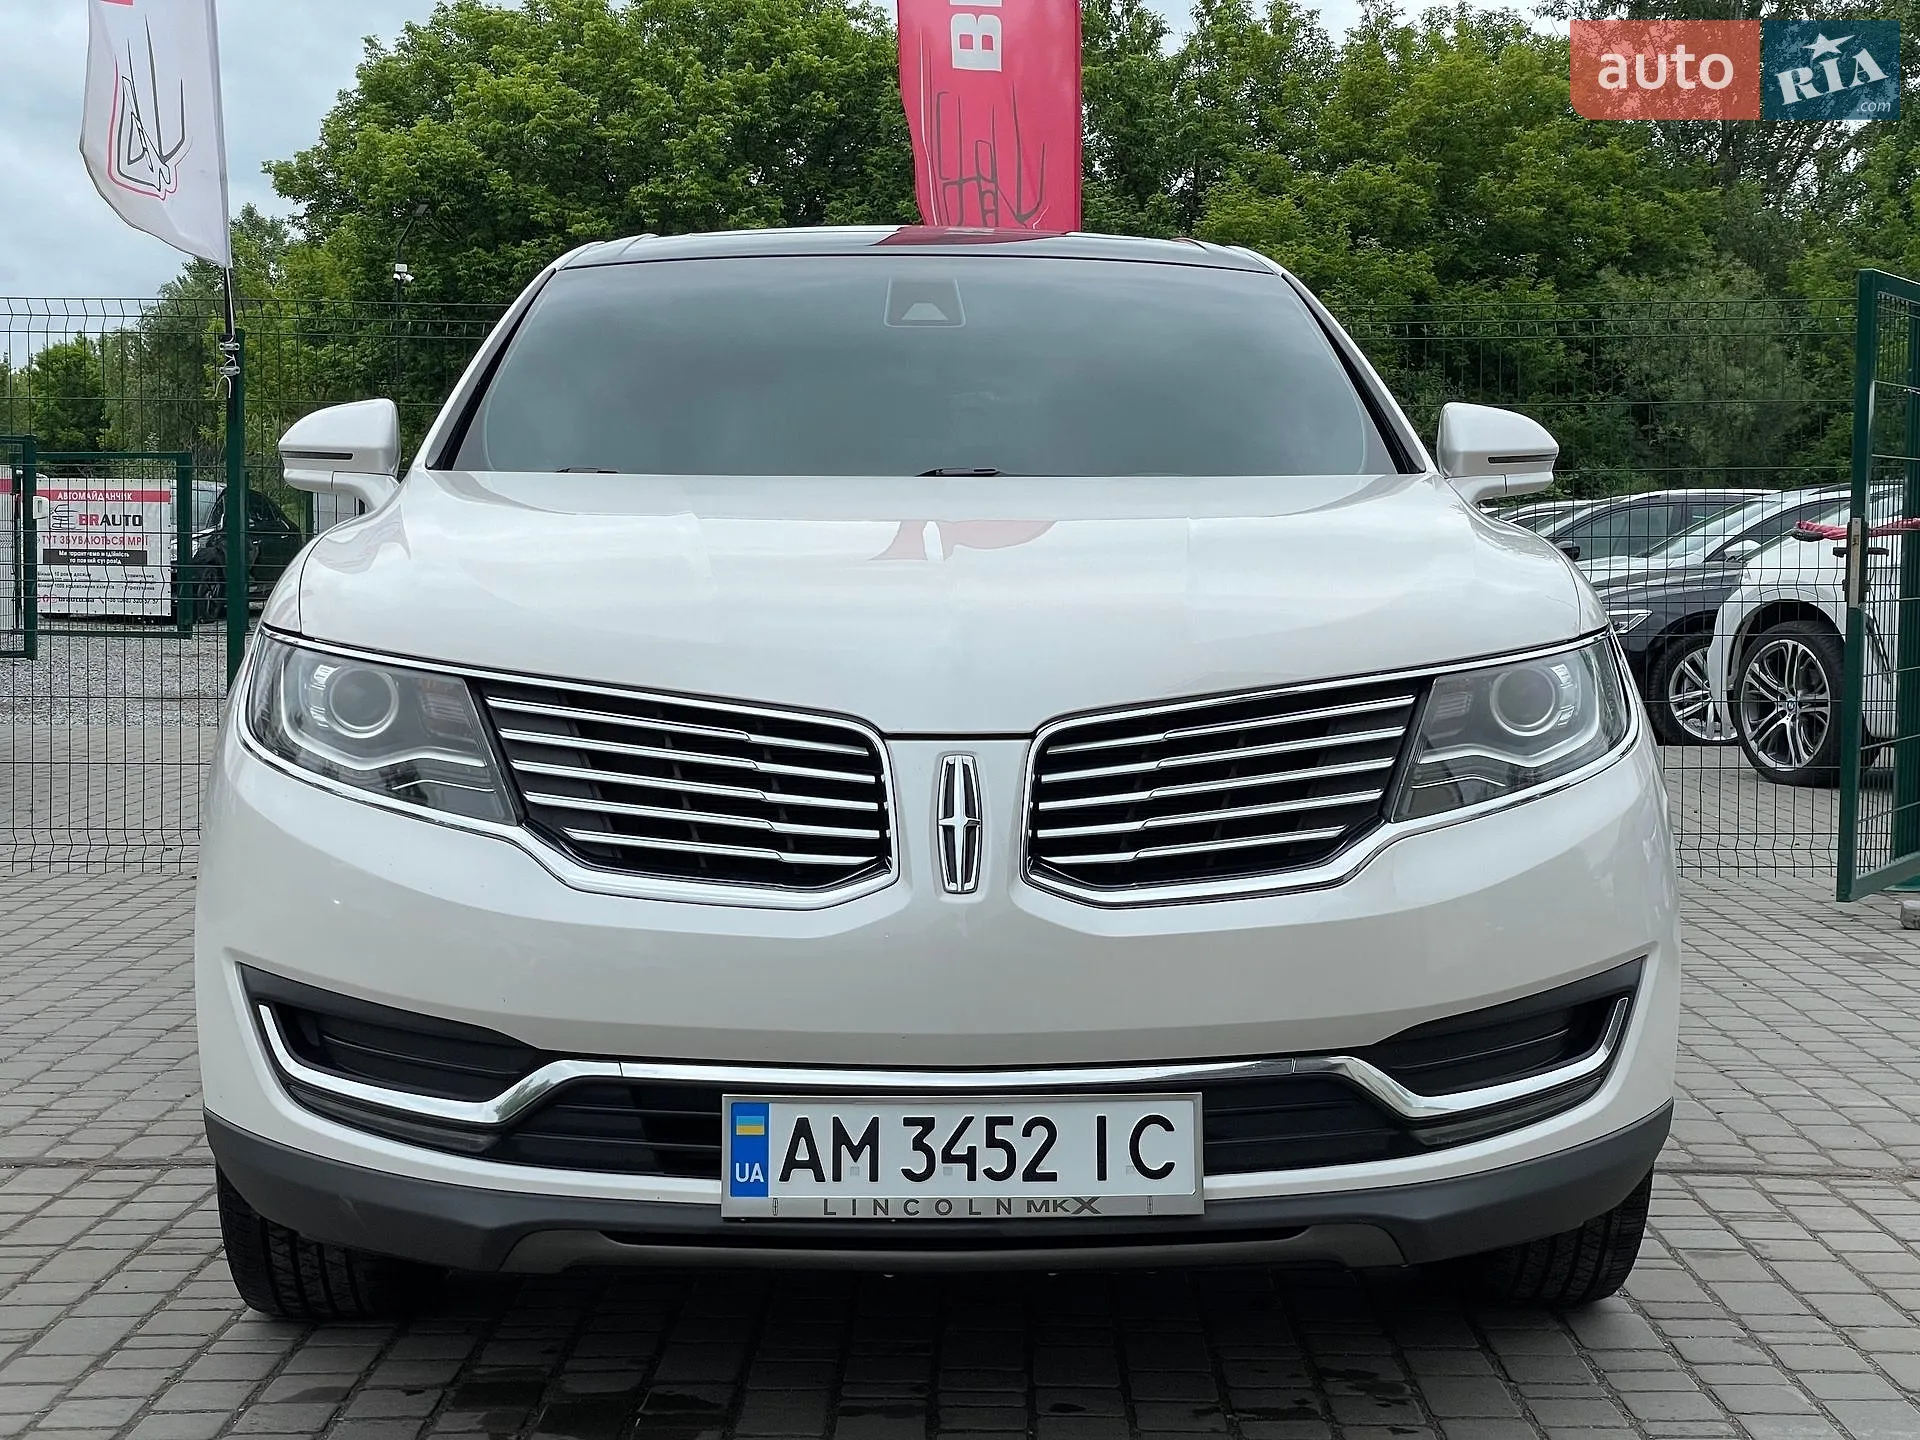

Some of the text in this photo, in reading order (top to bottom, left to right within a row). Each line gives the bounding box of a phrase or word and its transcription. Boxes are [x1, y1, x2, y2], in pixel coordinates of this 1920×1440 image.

[949, 0, 1003, 72] B
[57, 490, 133, 501] АВТОМАЙДАНЧИК
[78, 513, 143, 526] BRAUTO
[42, 535, 149, 546] ТУТ ЗБУВАЮТЬСЯ МРЇ
[778, 1115, 880, 1183] AM
[900, 1115, 1058, 1183] 3452
[735, 1162, 765, 1183] UA
[823, 1196, 1102, 1217] LINCOLN MKX
